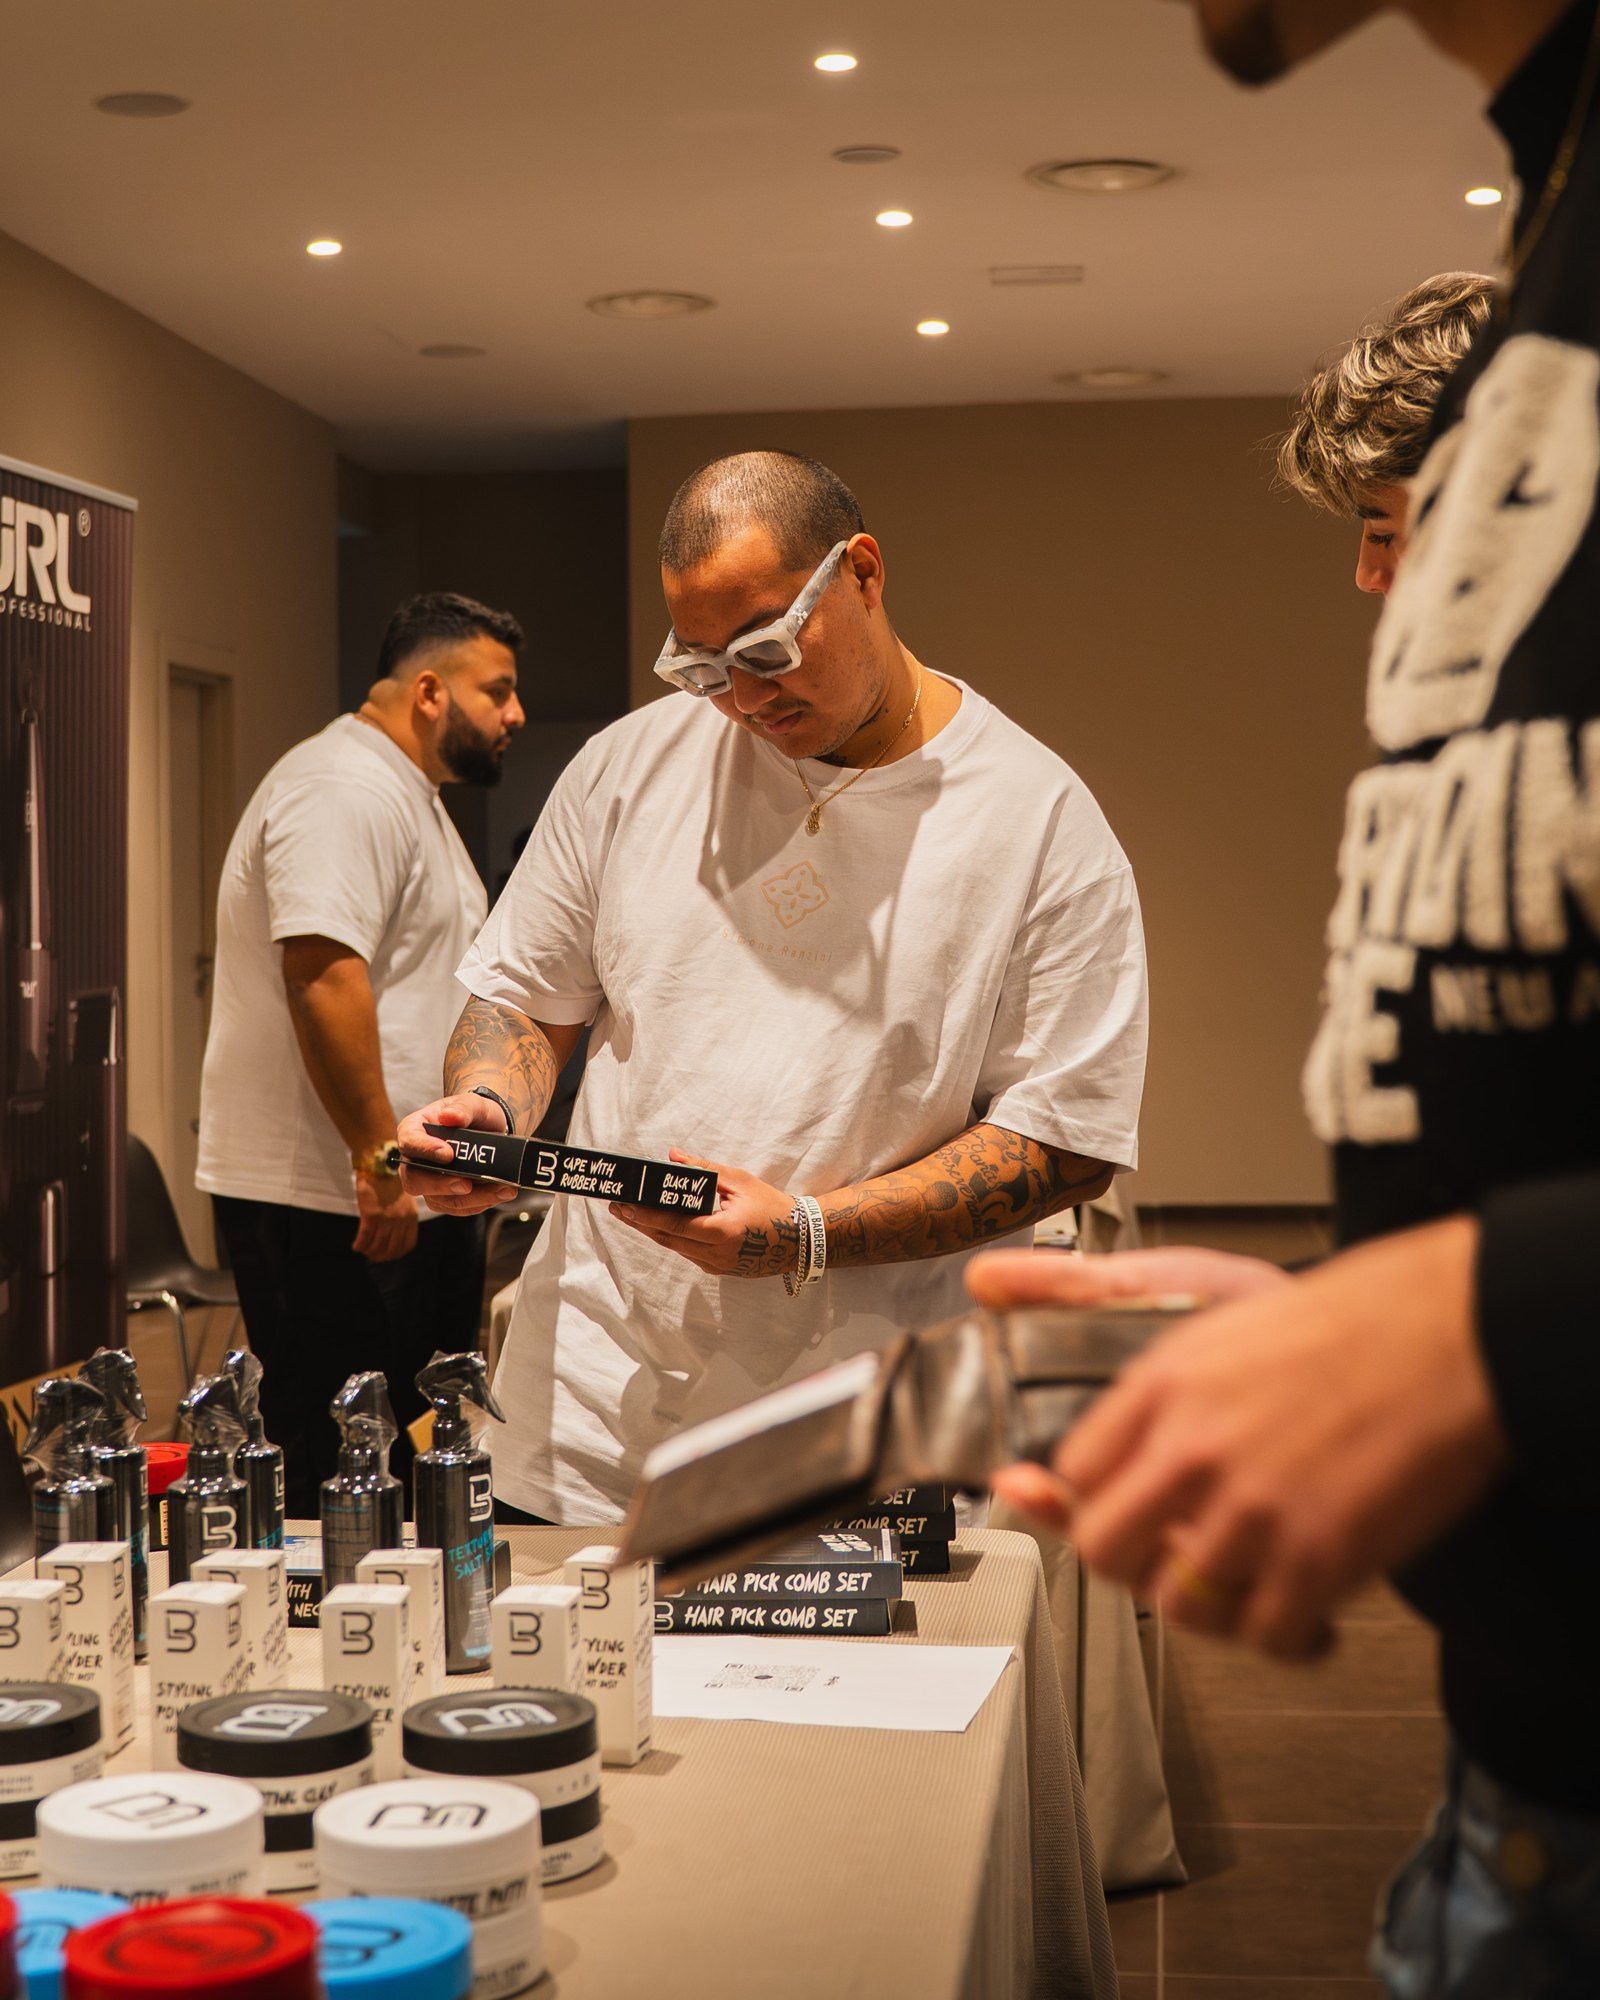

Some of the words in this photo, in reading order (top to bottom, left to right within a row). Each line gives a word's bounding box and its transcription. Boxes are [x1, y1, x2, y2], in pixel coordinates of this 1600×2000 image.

[563, 1156, 588, 1174] CAPE
[590, 1158, 617, 1178] WITH
[559, 1174, 596, 1193] RUBBER
[599, 1178, 625, 1197] NECK
[662, 1172, 691, 1192] BLACK
[659, 1189, 679, 1206] RED
[680, 1192, 704, 1210] TRIM
[811, 1217, 825, 1269] BARBERSHOP
[896, 1517, 928, 1535] SET
[697, 1572, 737, 1595] HAIR
[743, 1571, 781, 1594] PICK
[784, 1570, 831, 1594] COMB
[835, 1572, 873, 1593] SET
[684, 1604, 725, 1627] HAIR
[730, 1607, 768, 1628] PICK
[771, 1605, 817, 1629] COMB
[821, 1607, 858, 1628] SET
[157, 1682, 213, 1697] STYLING
